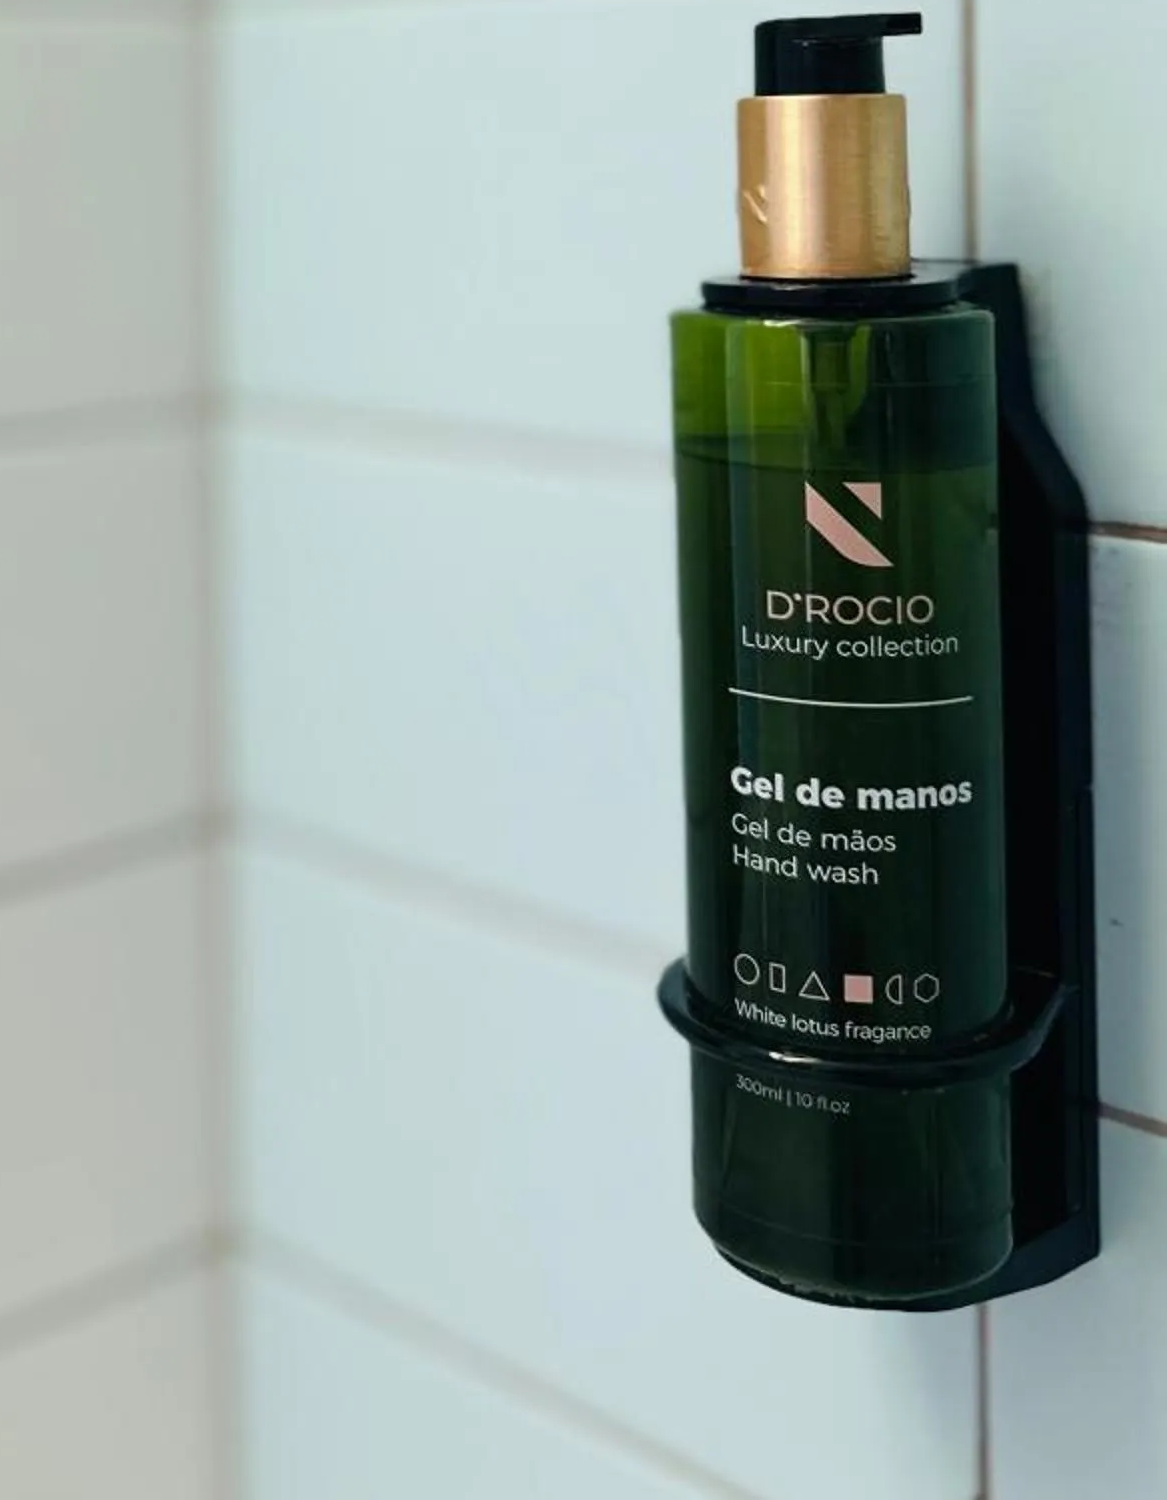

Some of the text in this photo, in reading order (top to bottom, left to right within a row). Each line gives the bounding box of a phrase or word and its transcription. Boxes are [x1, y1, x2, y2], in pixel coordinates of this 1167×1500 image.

[741, 625, 958, 661] Luxury collection
[730, 766, 973, 811] Gel de manos
[731, 812, 768, 840] Gel
[777, 822, 812, 848] de
[732, 843, 879, 885] Hand wash
[734, 997, 932, 1043] White lotus fragance
[735, 1073, 782, 1102] 300ml
